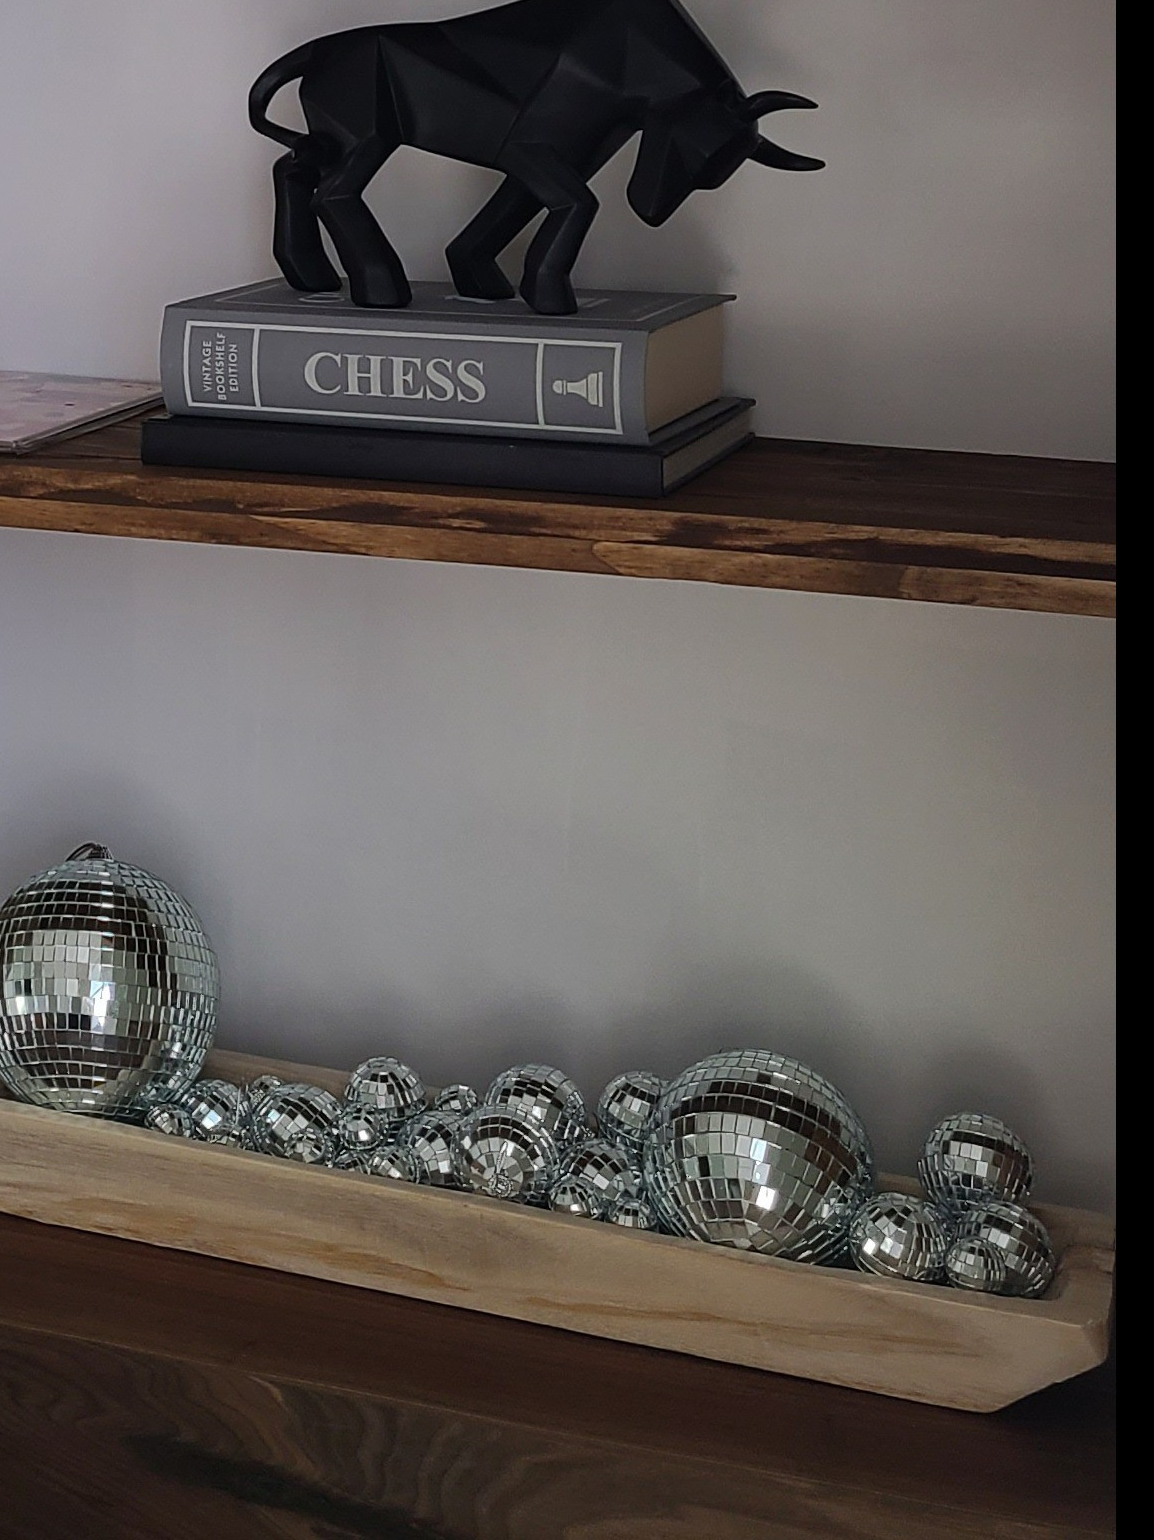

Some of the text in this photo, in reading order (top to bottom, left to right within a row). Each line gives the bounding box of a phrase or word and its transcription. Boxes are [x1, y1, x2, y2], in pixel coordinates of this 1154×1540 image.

[201, 340, 212, 392] VINTAGE
[215, 332, 228, 401] BOOKSHELF
[228, 344, 240, 392] EDITION
[303, 350, 486, 404] CHESS
